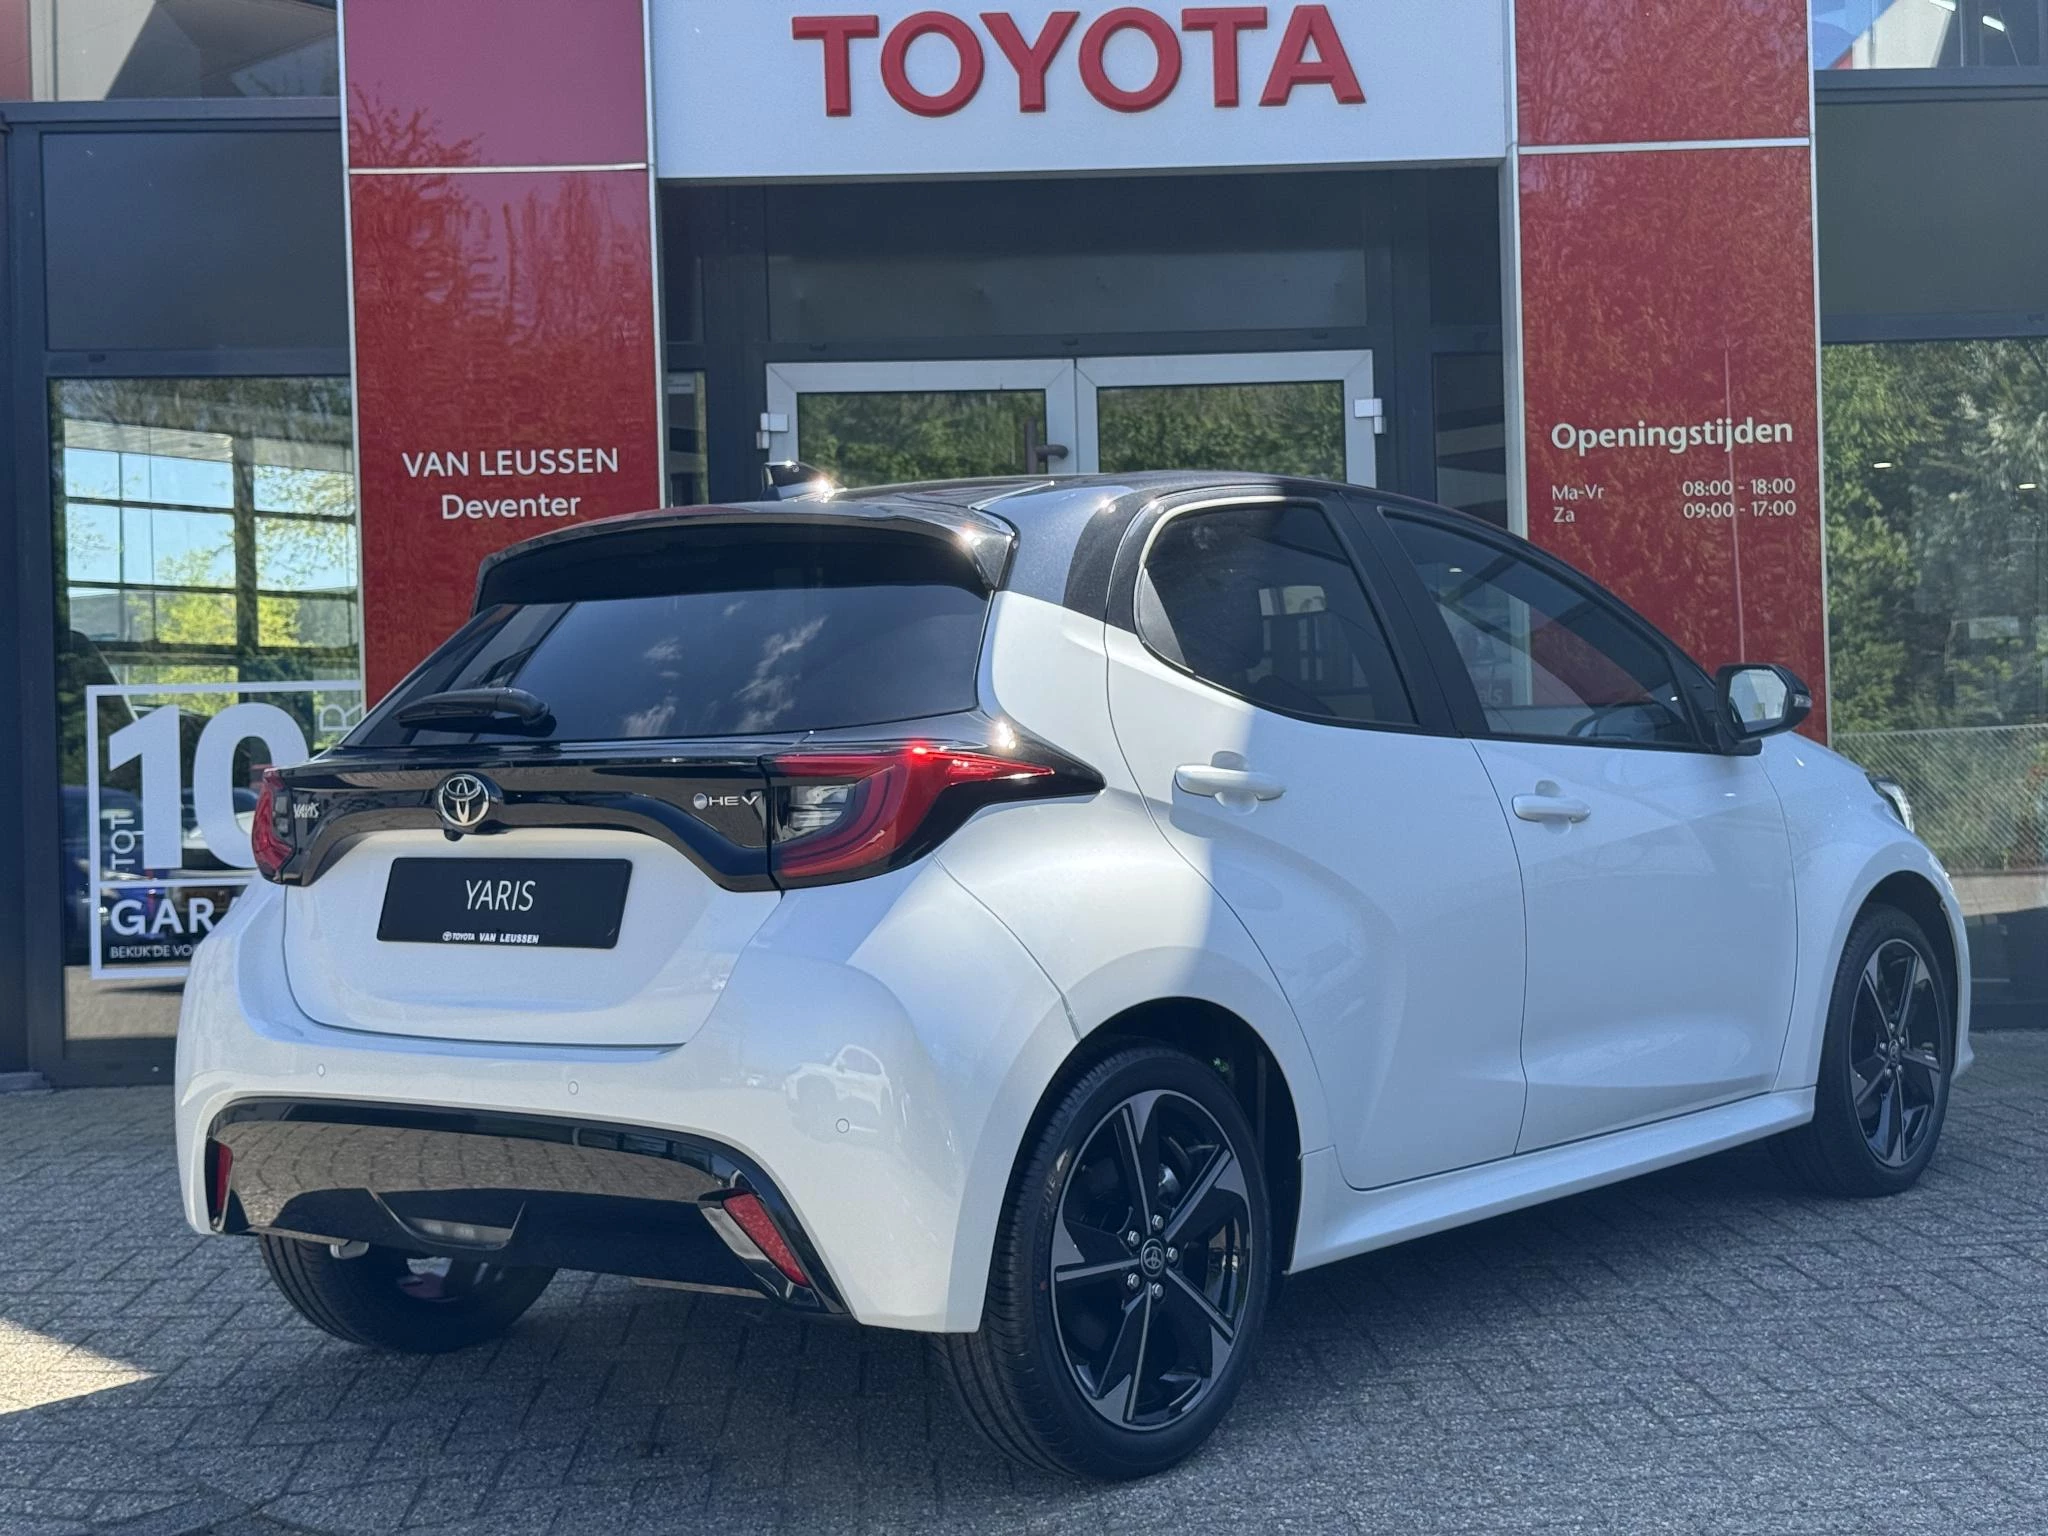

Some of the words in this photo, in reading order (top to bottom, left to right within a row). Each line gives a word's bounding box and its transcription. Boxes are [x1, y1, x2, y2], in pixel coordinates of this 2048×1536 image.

[792, 5, 1365, 118] TOYOTA
[1551, 417, 1793, 456] Openingstijden
[402, 451, 469, 477] VAN
[480, 448, 618, 476] LEUSSEN
[1552, 484, 1604, 500] Ma-Vr
[1682, 480, 1733, 496] 08:00
[1751, 478, 1796, 494] 18:00
[441, 494, 581, 519] Deventer
[1553, 507, 1575, 523] Za
[1683, 502, 1734, 518] 09:00
[1751, 500, 1797, 516] 17:00
[708, 796, 758, 806] HEV
[111, 815, 135, 870] TOT
[466, 880, 536, 911] YARIS
[111, 896, 239, 936] GAR
[153, 945, 170, 957] DE
[173, 944, 196, 956] VO
[452, 933, 475, 941] TOYOTA
[480, 933, 496, 942] VAN
[500, 933, 539, 944] LEUSSEN
